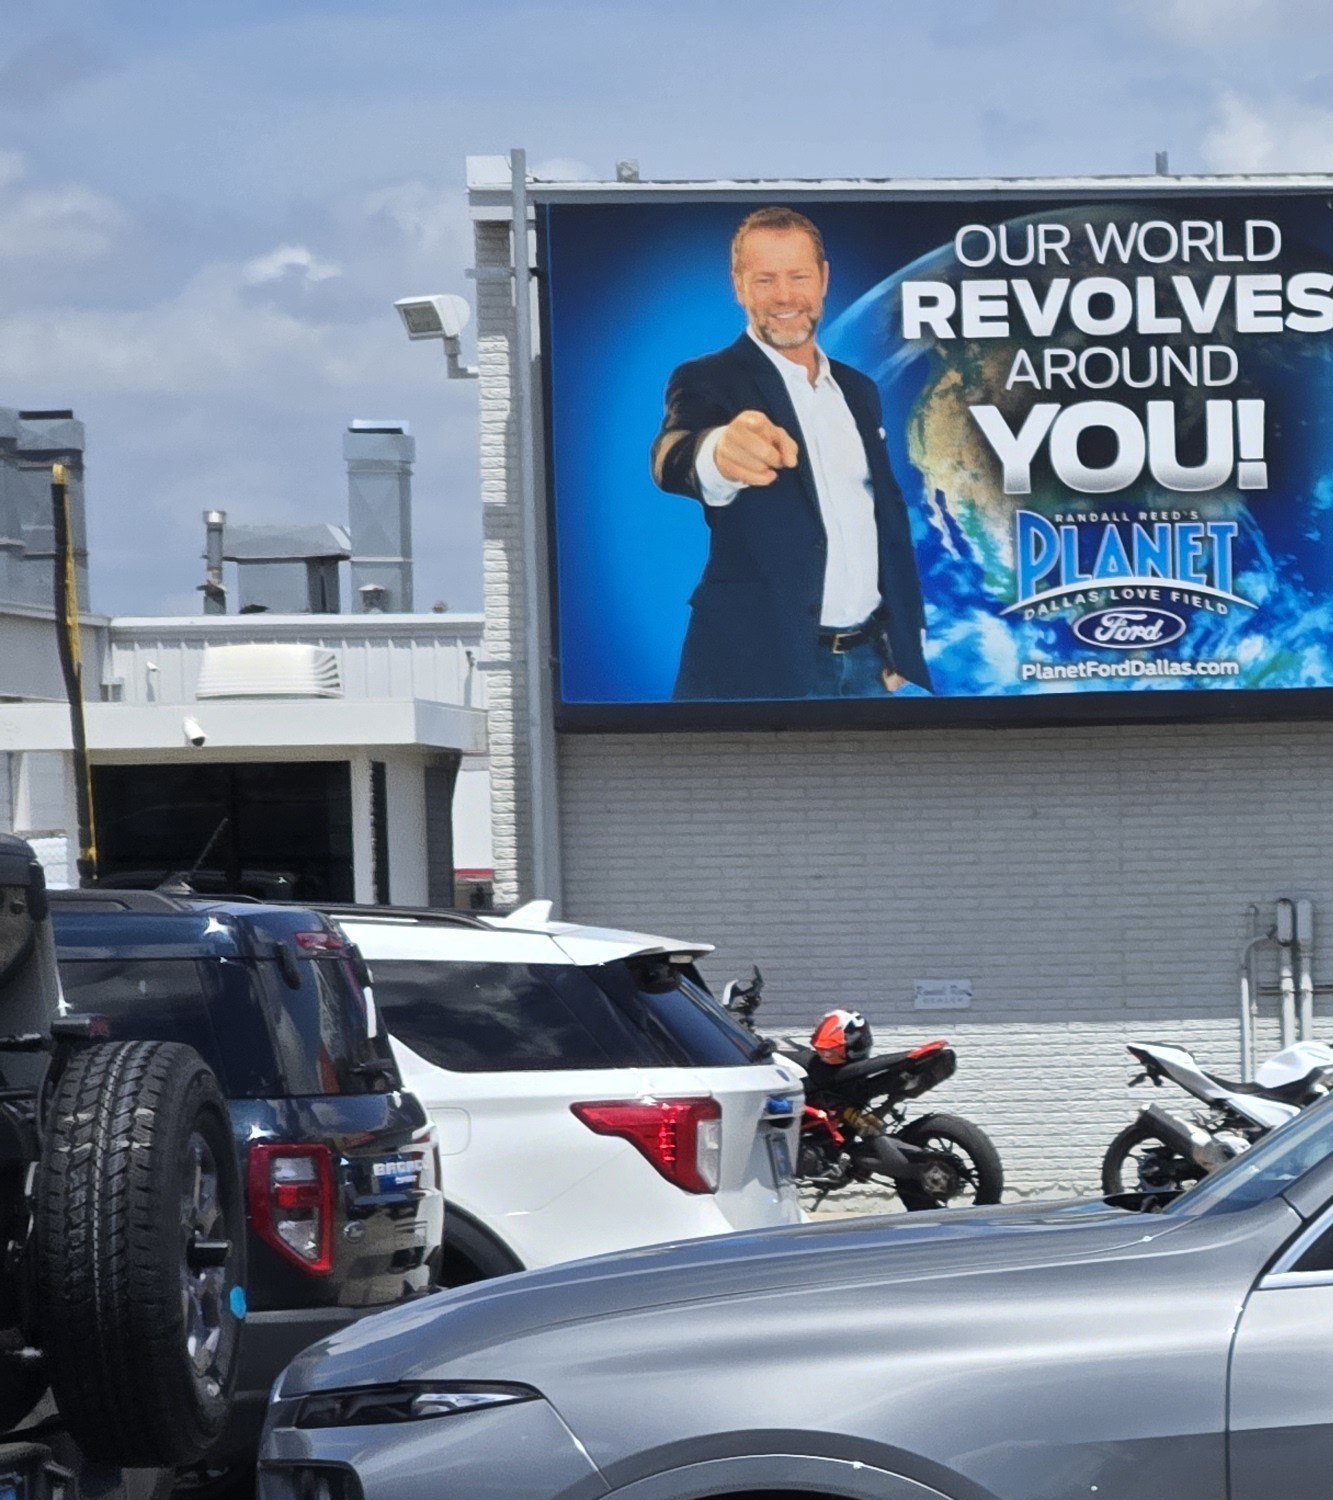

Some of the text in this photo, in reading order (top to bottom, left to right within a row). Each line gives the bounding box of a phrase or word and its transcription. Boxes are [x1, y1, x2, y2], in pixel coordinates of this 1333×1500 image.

[954, 219, 1282, 268] OUR WORLD
[1004, 345, 1239, 391] AROUND
[968, 398, 1269, 496] YOU!
[1054, 511, 1131, 523] RANDALL
[1015, 509, 1239, 603] PLANET
[1023, 588, 1229, 621] DALLAS LOVE FIELD
[1094, 613, 1165, 642] Ford
[1020, 659, 1240, 682] PlanetFordDallas.com
